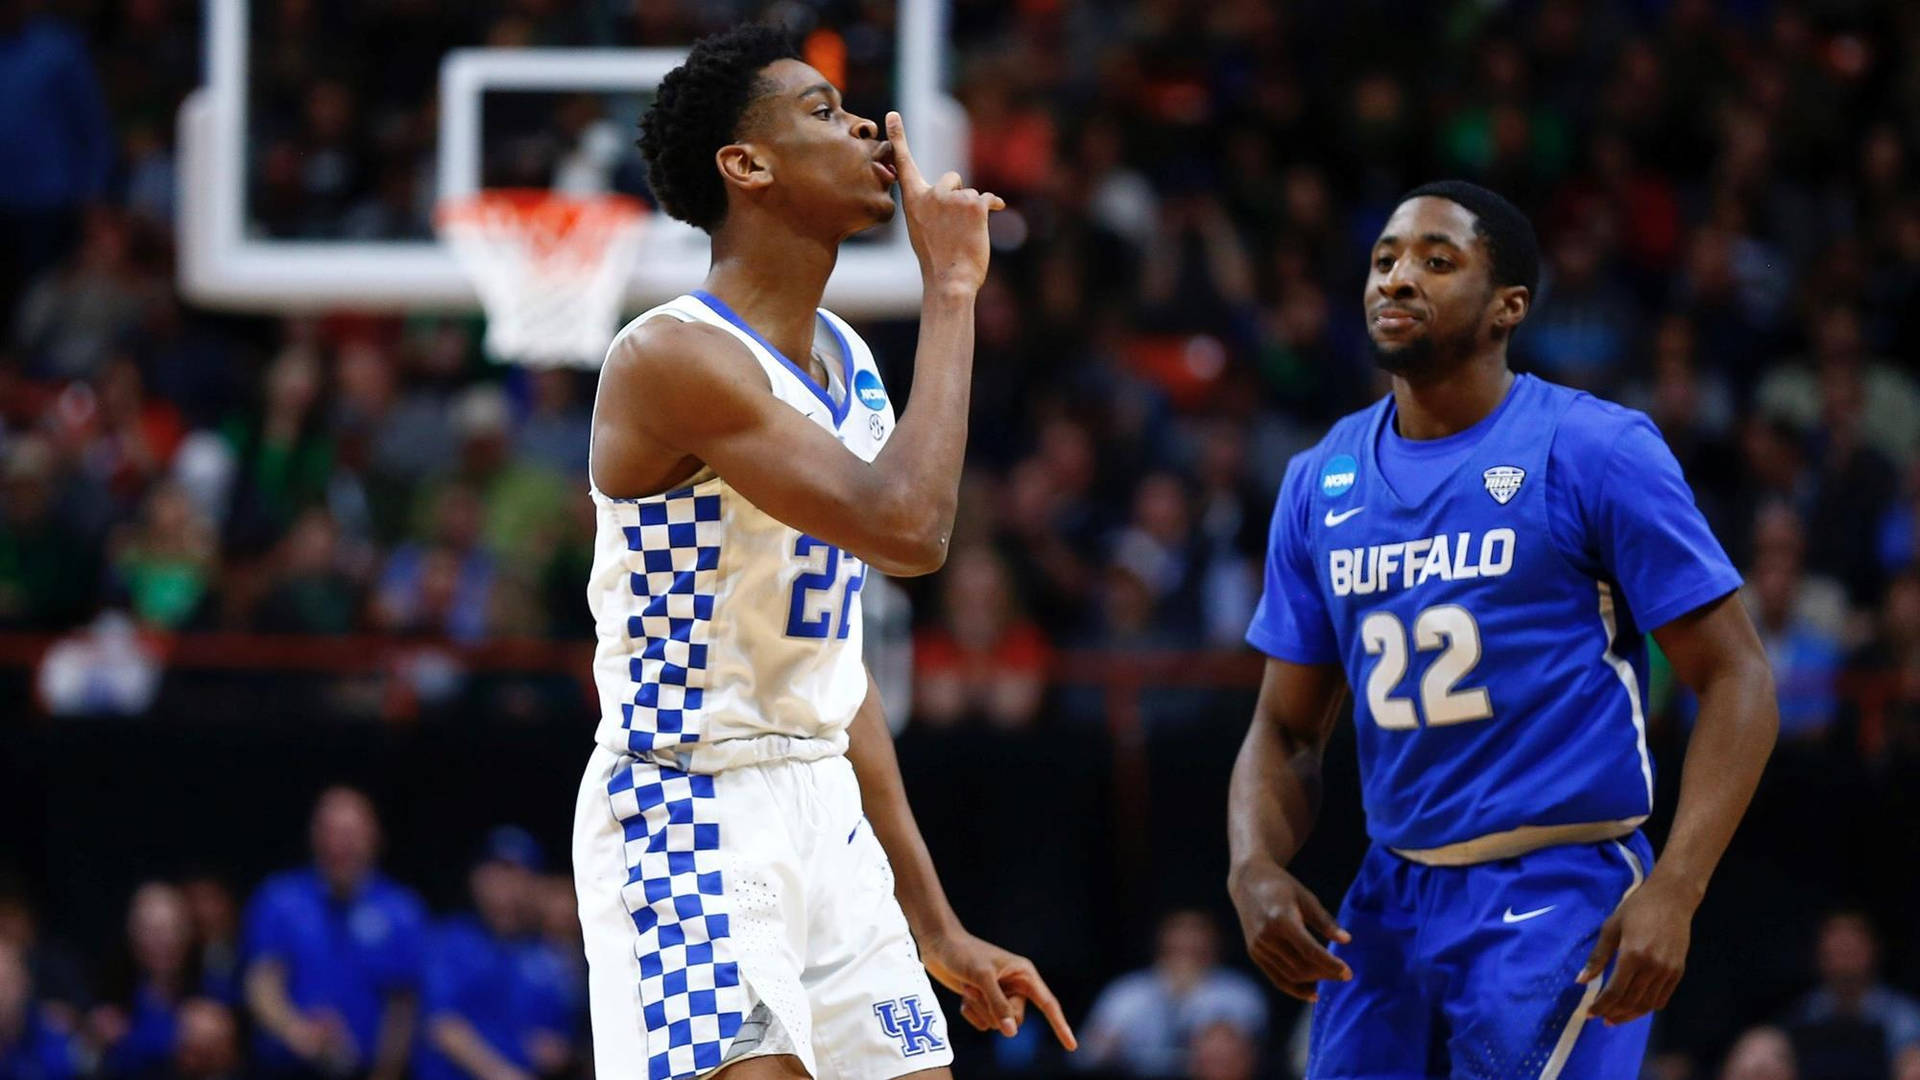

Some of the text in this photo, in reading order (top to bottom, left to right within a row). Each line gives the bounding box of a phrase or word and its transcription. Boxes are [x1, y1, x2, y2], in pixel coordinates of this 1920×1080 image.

[1324, 472, 1355, 488] NCAA
[1486, 475, 1521, 489] MAC
[1330, 528, 1516, 596] BUFFALO
[1362, 604, 1493, 729] 22
[872, 994, 945, 1057] UK
